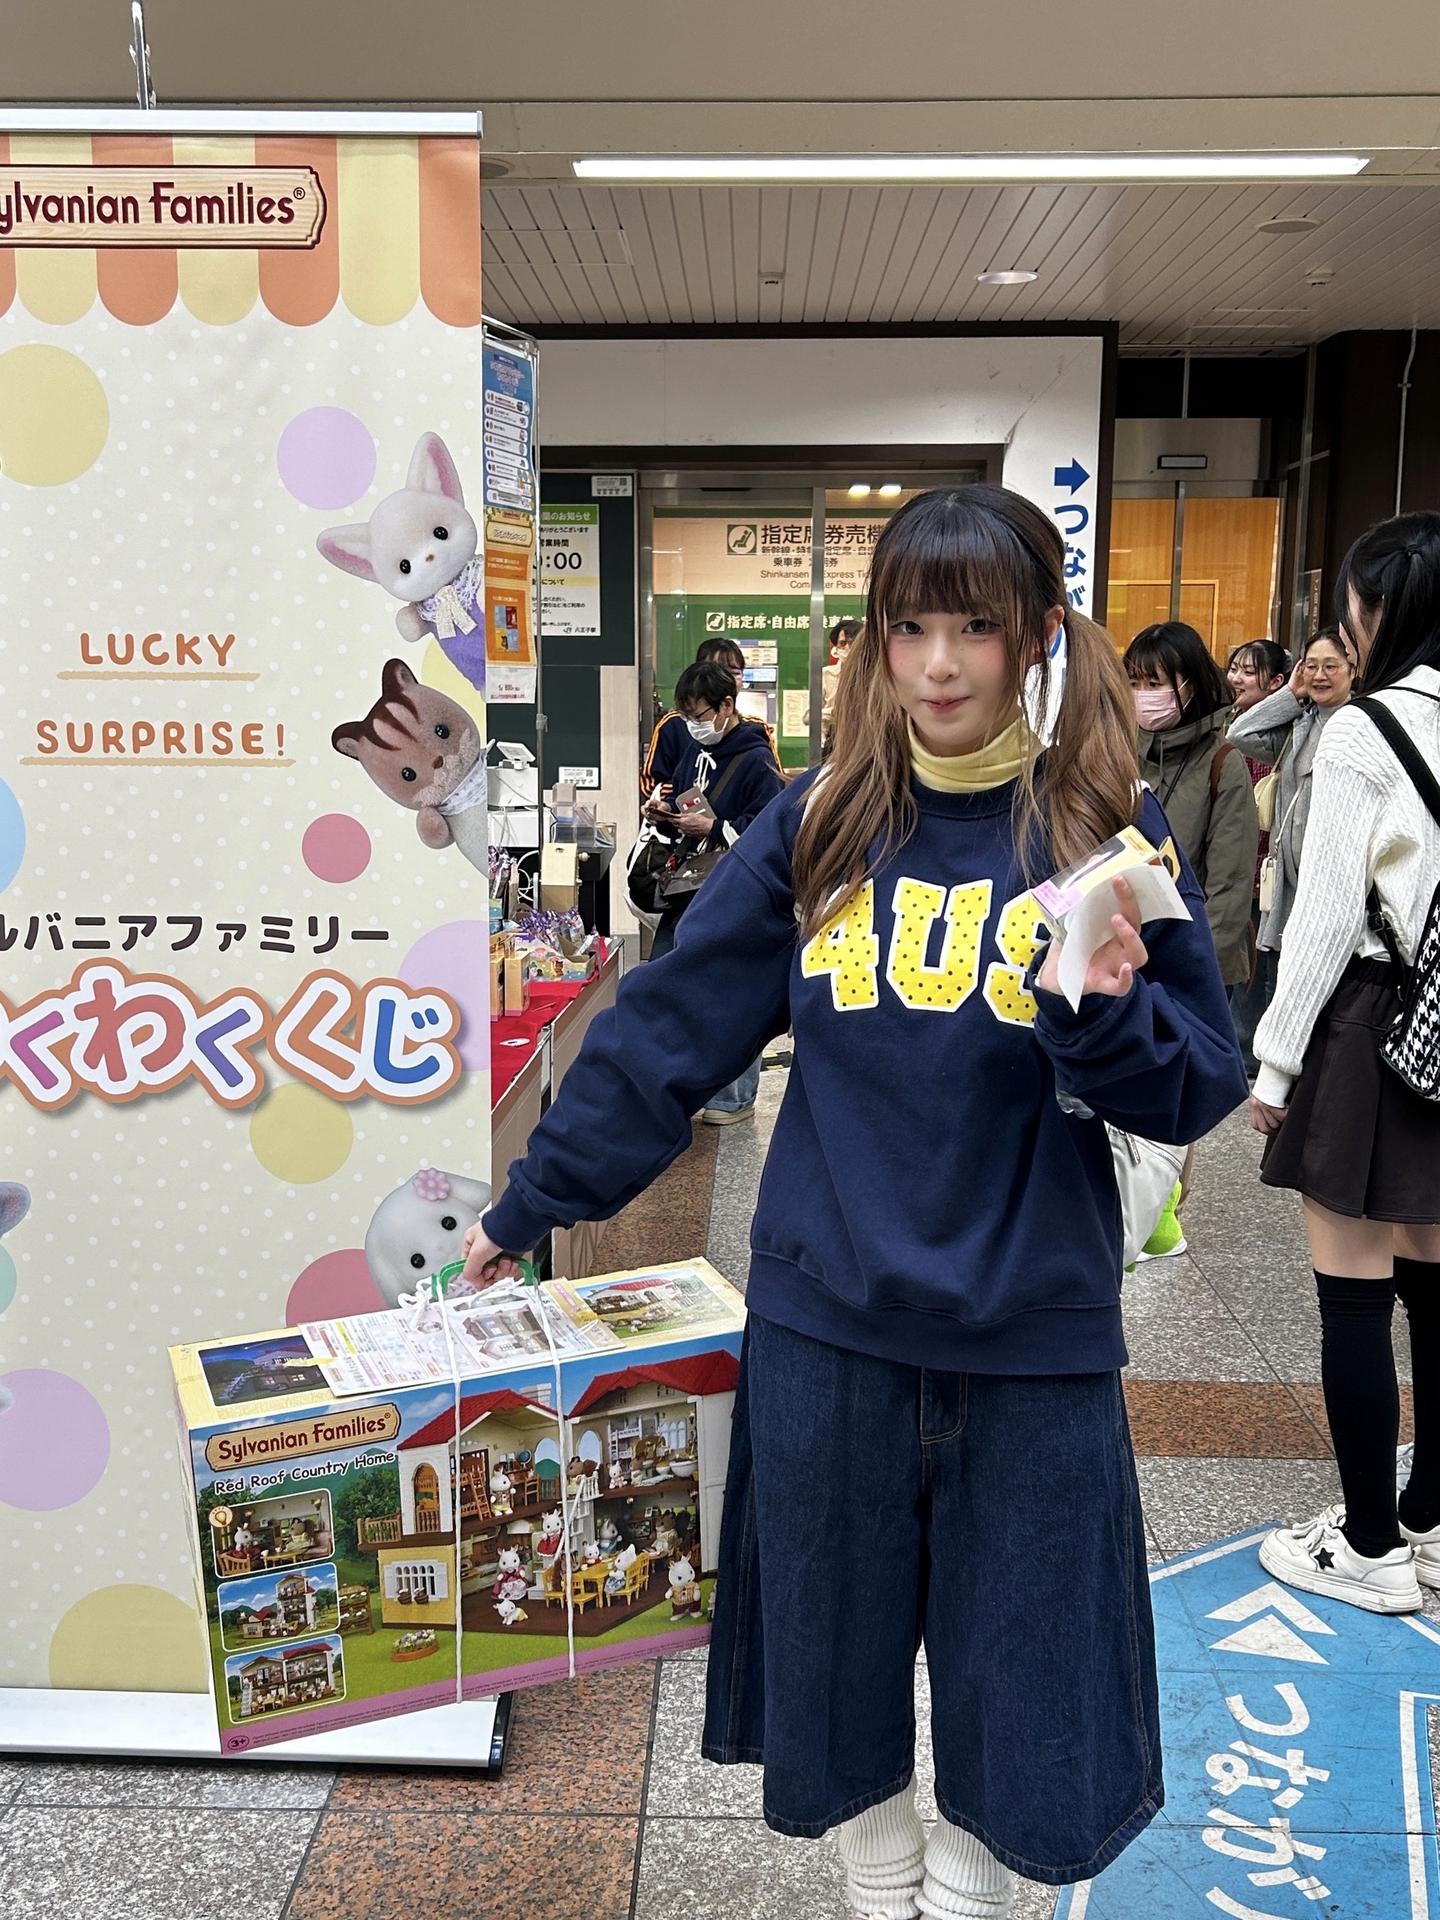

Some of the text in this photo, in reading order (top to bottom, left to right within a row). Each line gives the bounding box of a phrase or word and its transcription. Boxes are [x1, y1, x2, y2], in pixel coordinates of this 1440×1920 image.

[760, 569, 809, 579] Shinkansen
[836, 580, 857, 589] Pass
[80, 632, 236, 667] LUCKY
[36, 719, 285, 757] SURPRISE!
[218, 1432, 309, 1463] Sylvanian
[215, 1452, 395, 1495] Red Roof Country Home
